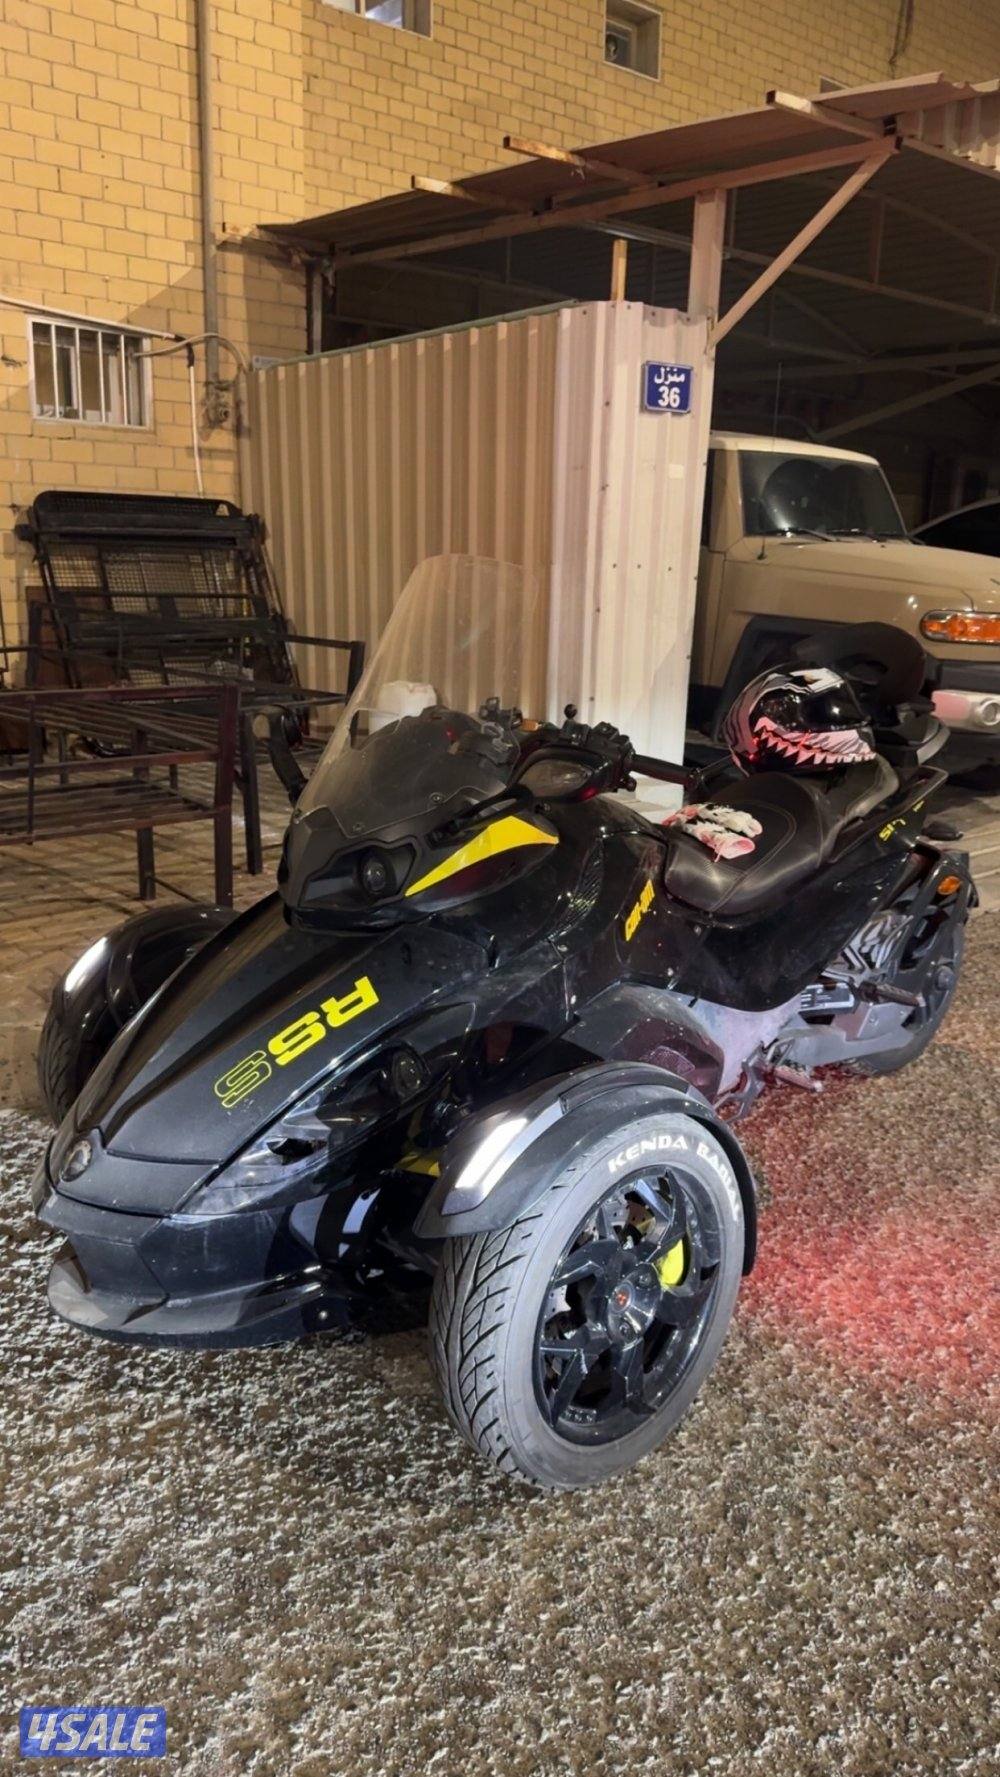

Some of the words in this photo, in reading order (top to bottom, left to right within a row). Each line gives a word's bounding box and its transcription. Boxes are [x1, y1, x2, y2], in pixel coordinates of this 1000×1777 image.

[654, 367, 685, 385] منزل
[658, 386, 680, 408] 36
[214, 976, 379, 1108] RSS
[607, 1135, 688, 1173] KENDA
